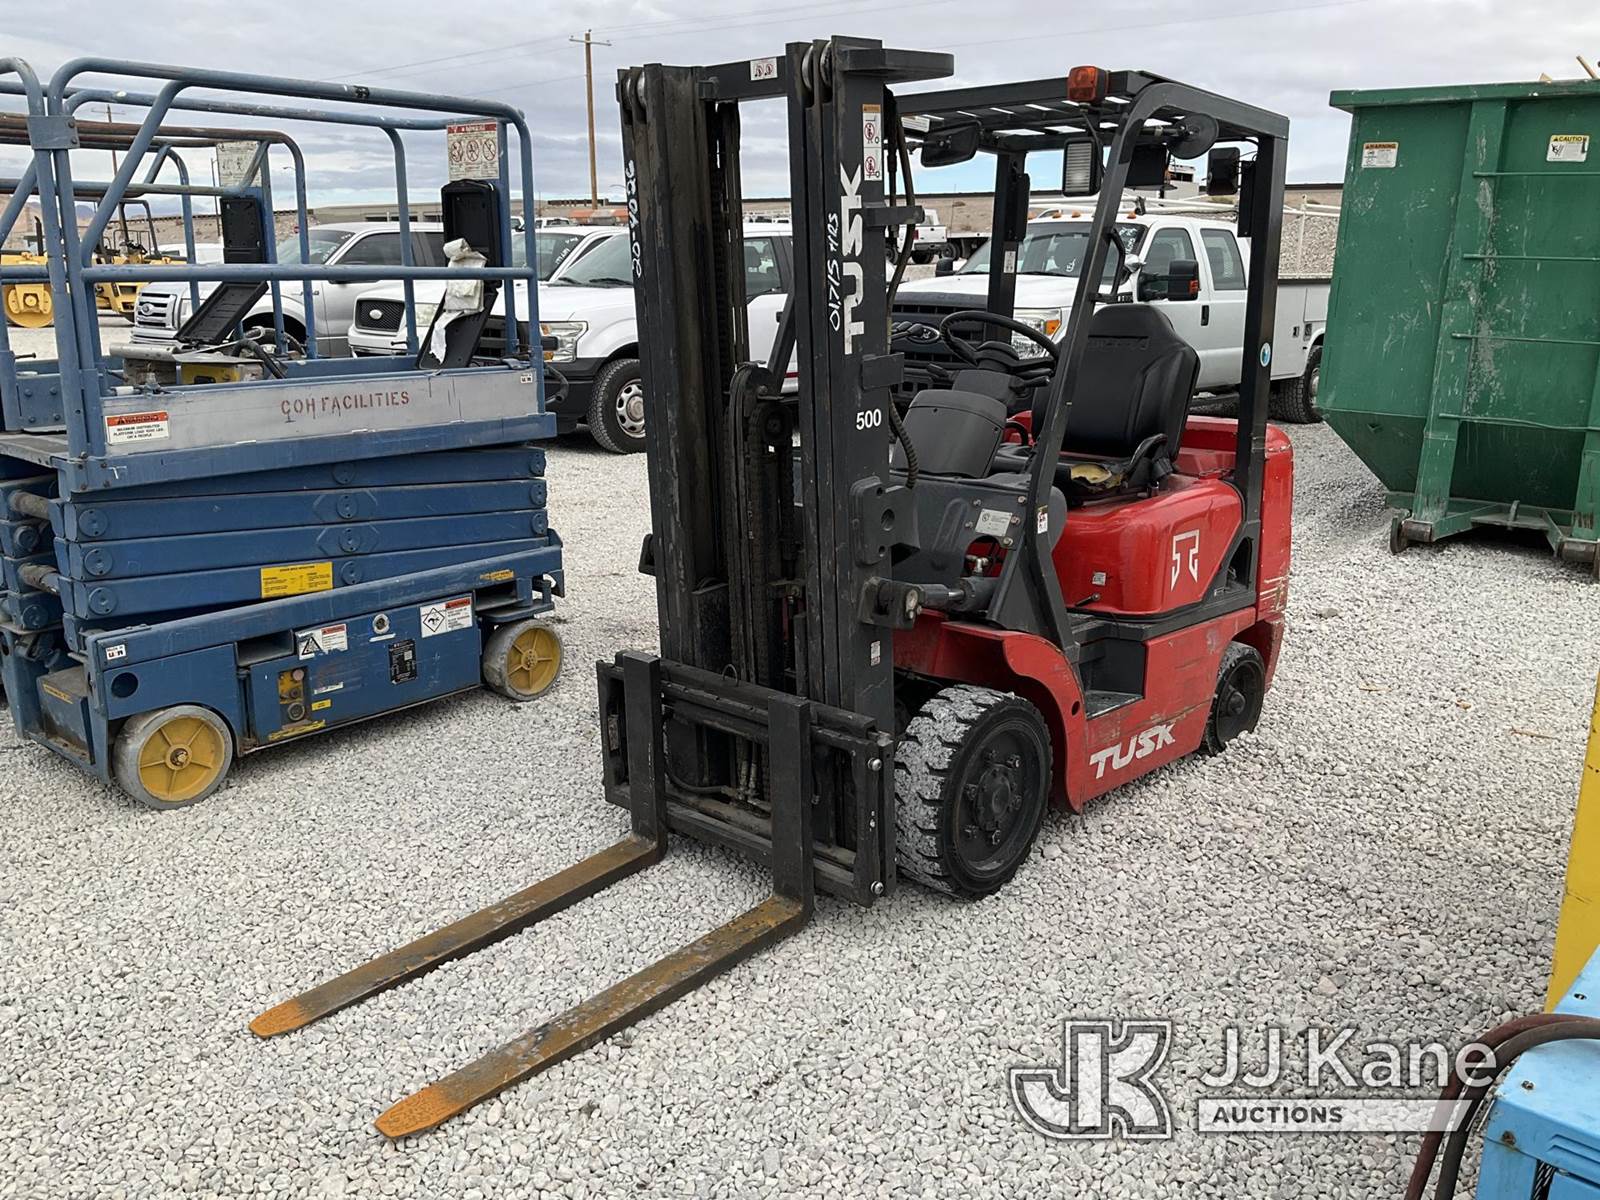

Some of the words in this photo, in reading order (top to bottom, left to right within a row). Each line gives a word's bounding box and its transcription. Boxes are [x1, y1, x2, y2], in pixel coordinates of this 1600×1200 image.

[839, 161, 865, 355] TUSK
[321, 391, 410, 416] FACILITIES
[856, 408, 882, 431] 500
[1089, 723, 1175, 779] TUSK
